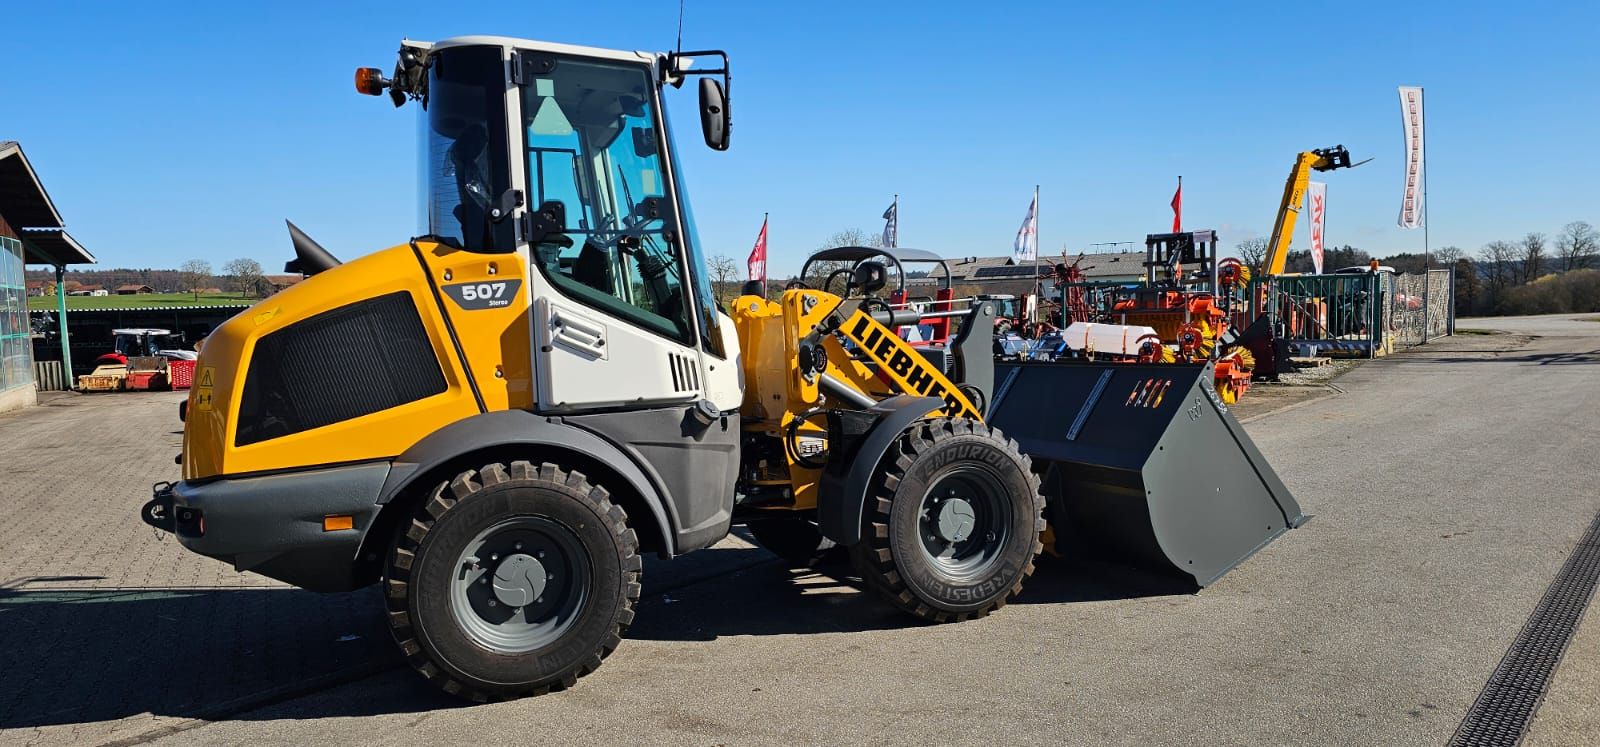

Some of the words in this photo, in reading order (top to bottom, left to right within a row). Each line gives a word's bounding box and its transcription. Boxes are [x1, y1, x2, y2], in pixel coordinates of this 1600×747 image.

[462, 282, 506, 300] 507
[923, 444, 1012, 475] ENDURION
[920, 561, 1016, 601] VREDESTEIN
